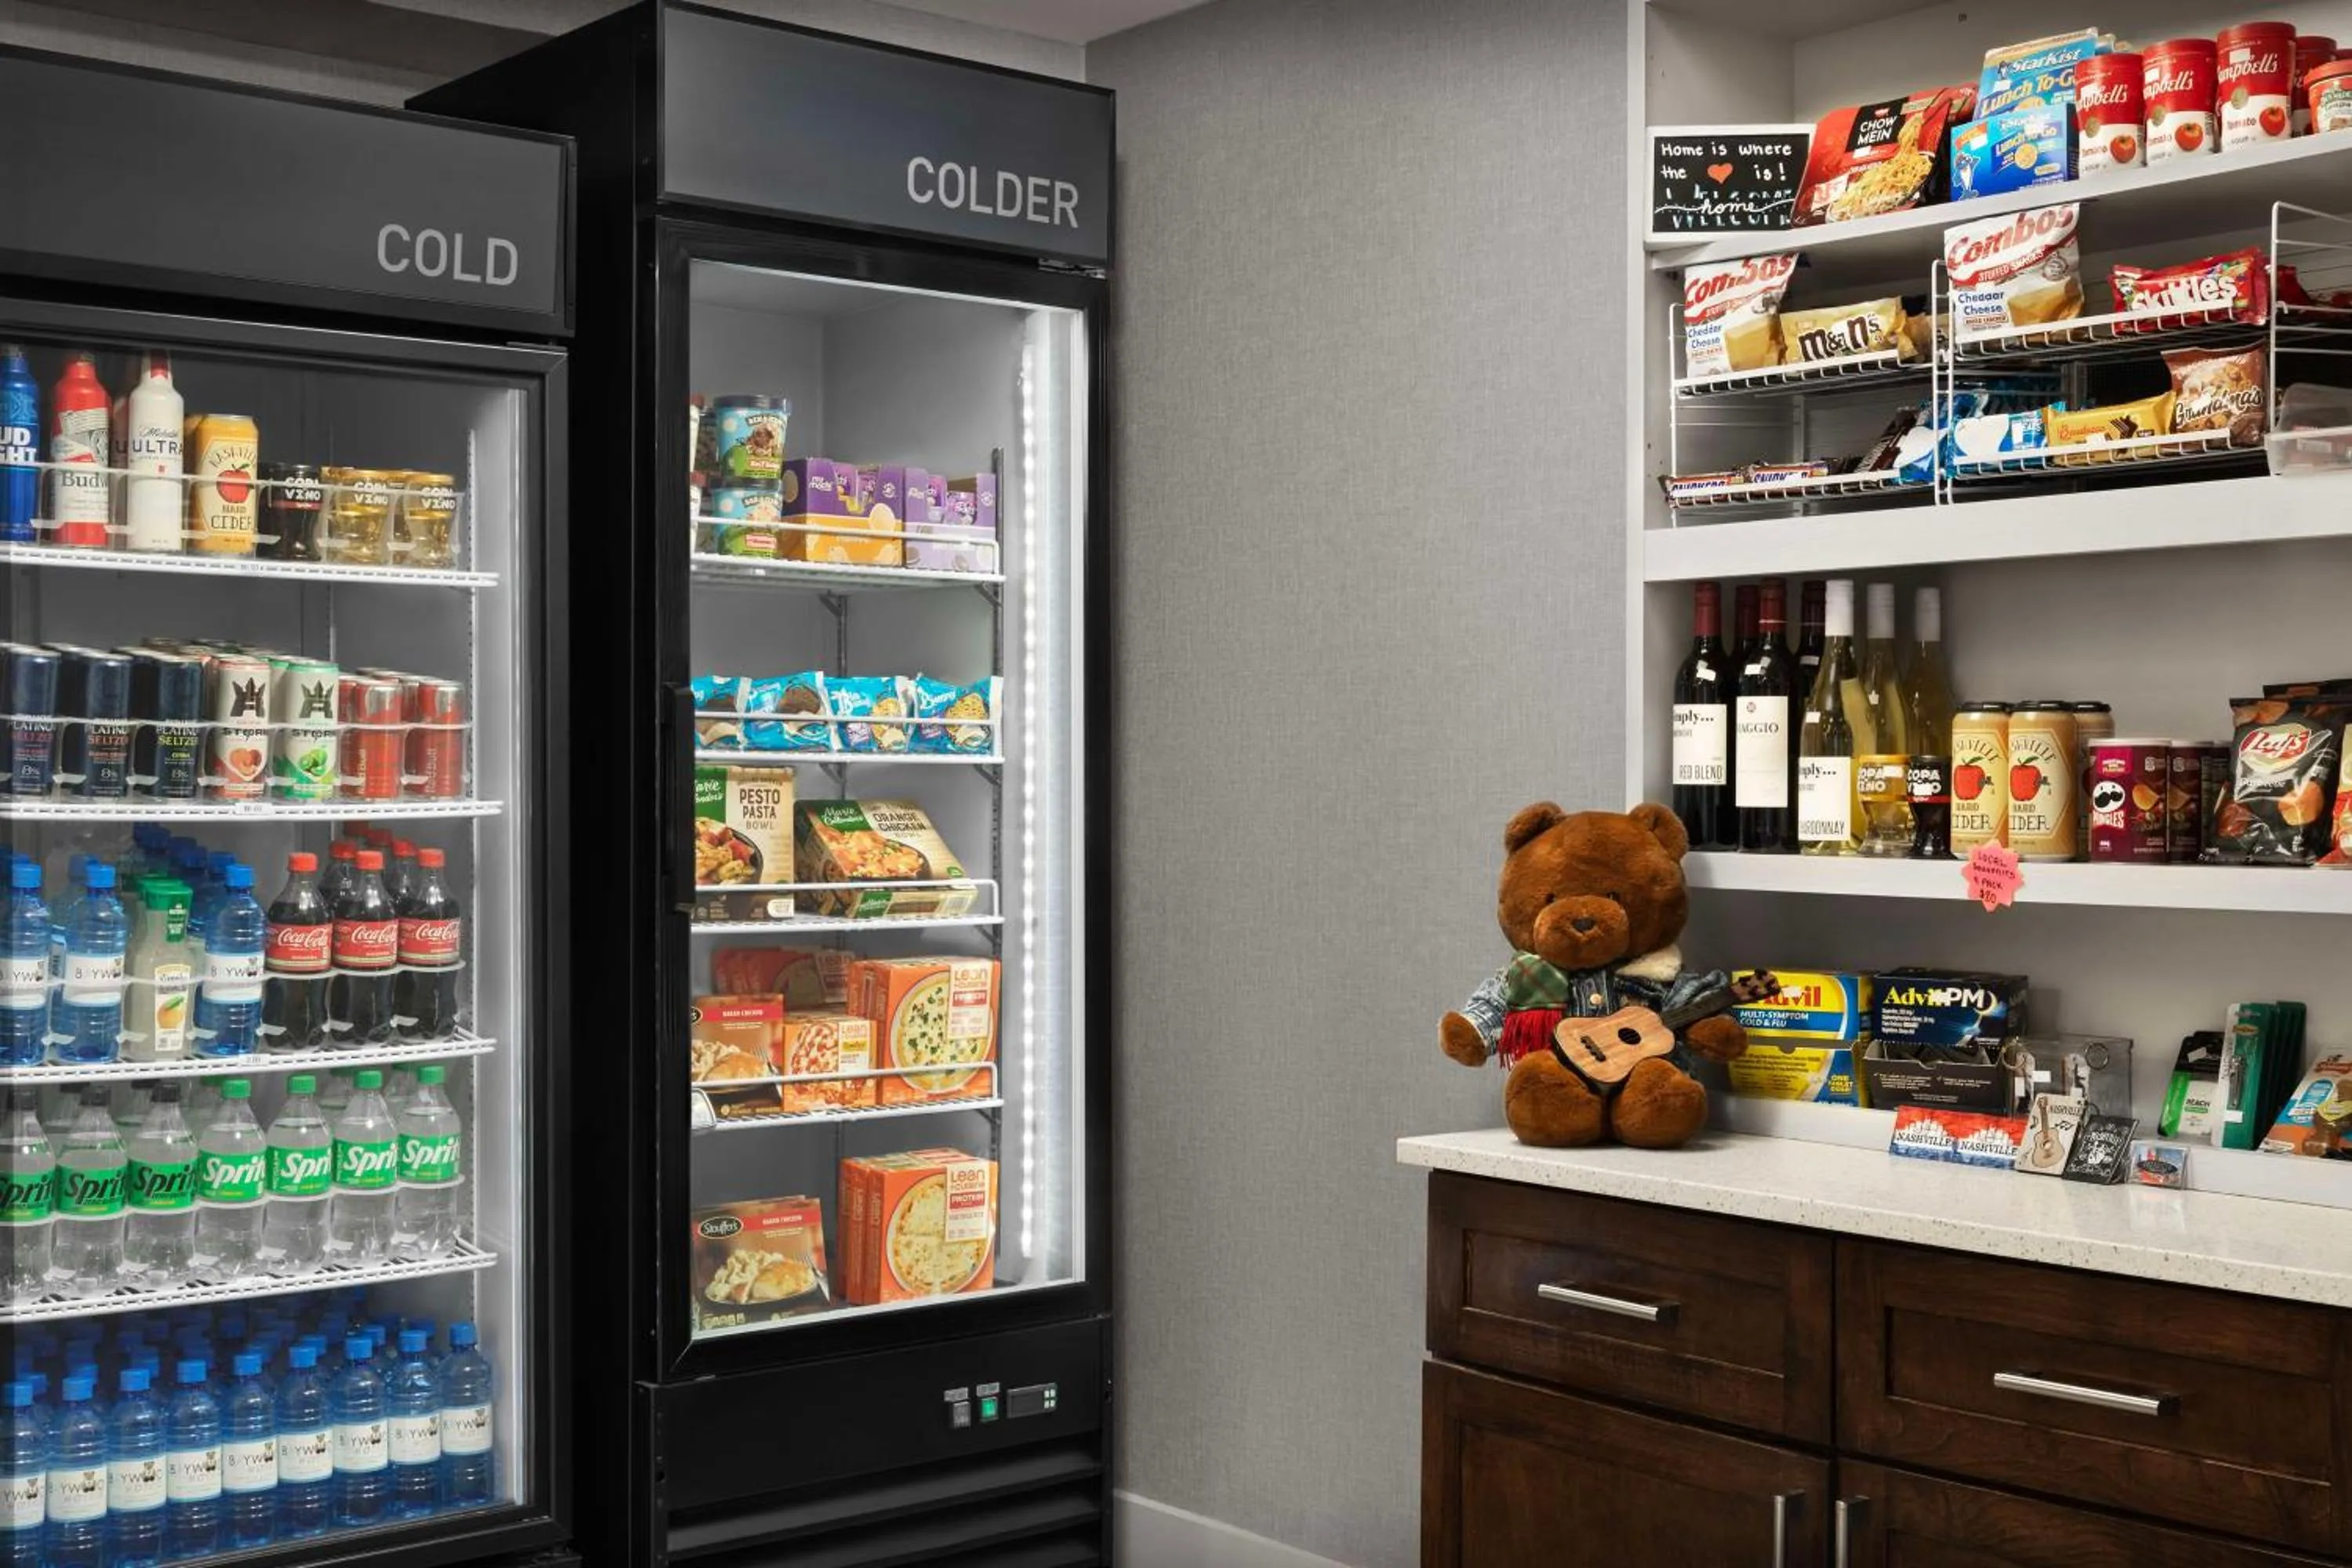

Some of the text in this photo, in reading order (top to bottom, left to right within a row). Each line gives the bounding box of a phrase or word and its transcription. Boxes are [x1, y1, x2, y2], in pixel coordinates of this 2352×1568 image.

[2012, 47, 2082, 72] StarKist
[1982, 82, 2033, 115] Lunch
[1859, 116, 1898, 132] CHOW
[1857, 129, 1893, 145] MEIN
[1661, 141, 1792, 156] Home is where
[1660, 164, 1688, 180] the
[907, 156, 1080, 229] COLDER
[1947, 205, 2074, 270] Combos
[377, 223, 518, 286] COLD
[1958, 291, 2005, 304] Cheddar
[1963, 303, 2003, 315] Cheese
[0, 427, 31, 446] UD
[285, 488, 321, 501] VINO
[354, 493, 389, 506] VINO
[2243, 730, 2308, 759] Lay's
[1679, 764, 1723, 780] RED BLEND
[695, 779, 720, 792] arie
[739, 788, 781, 805] PESTO
[742, 805, 777, 819] PASTA
[873, 812, 918, 822] ORANGE
[746, 821, 774, 830] BOWL
[877, 822, 927, 832] CHICKEN
[1952, 815, 1994, 830] IDER
[2009, 815, 2050, 830] IDER
[278, 927, 328, 949] Coca-Cola
[1944, 986, 1985, 1008] PM
[1739, 1018, 1763, 1027] COLD
[1740, 1010, 1809, 1022] MULTI-SYMPTOM
[1896, 1131, 1951, 1148] NASHVILLE
[1959, 1142, 2019, 1156] NASHVILLE
[950, 1169, 985, 1183] Lean
[704, 1220, 739, 1235] Stouffer's
